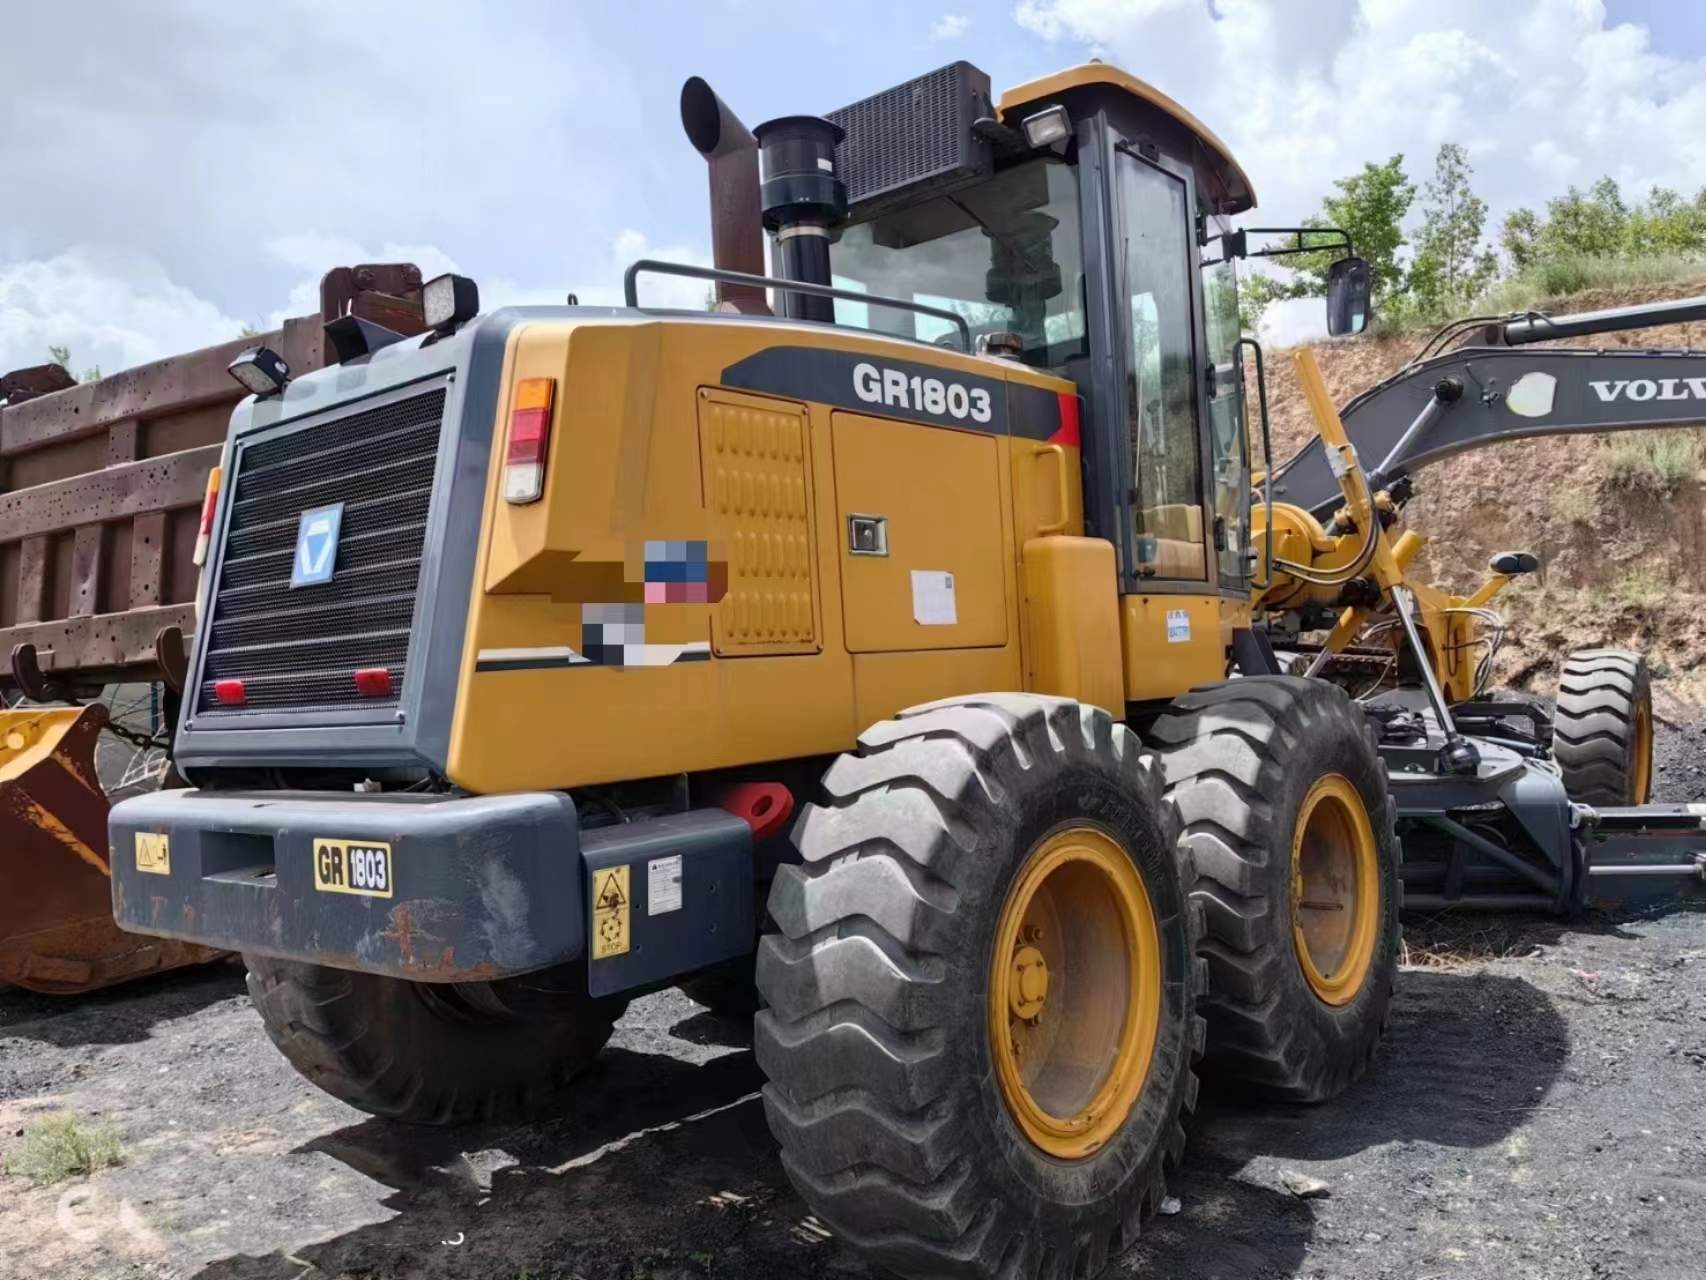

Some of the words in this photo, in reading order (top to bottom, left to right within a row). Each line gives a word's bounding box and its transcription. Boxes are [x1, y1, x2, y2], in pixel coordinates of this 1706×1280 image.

[853, 363, 991, 423] GR1803
[318, 845, 344, 885] GR
[350, 848, 386, 889] 1803
